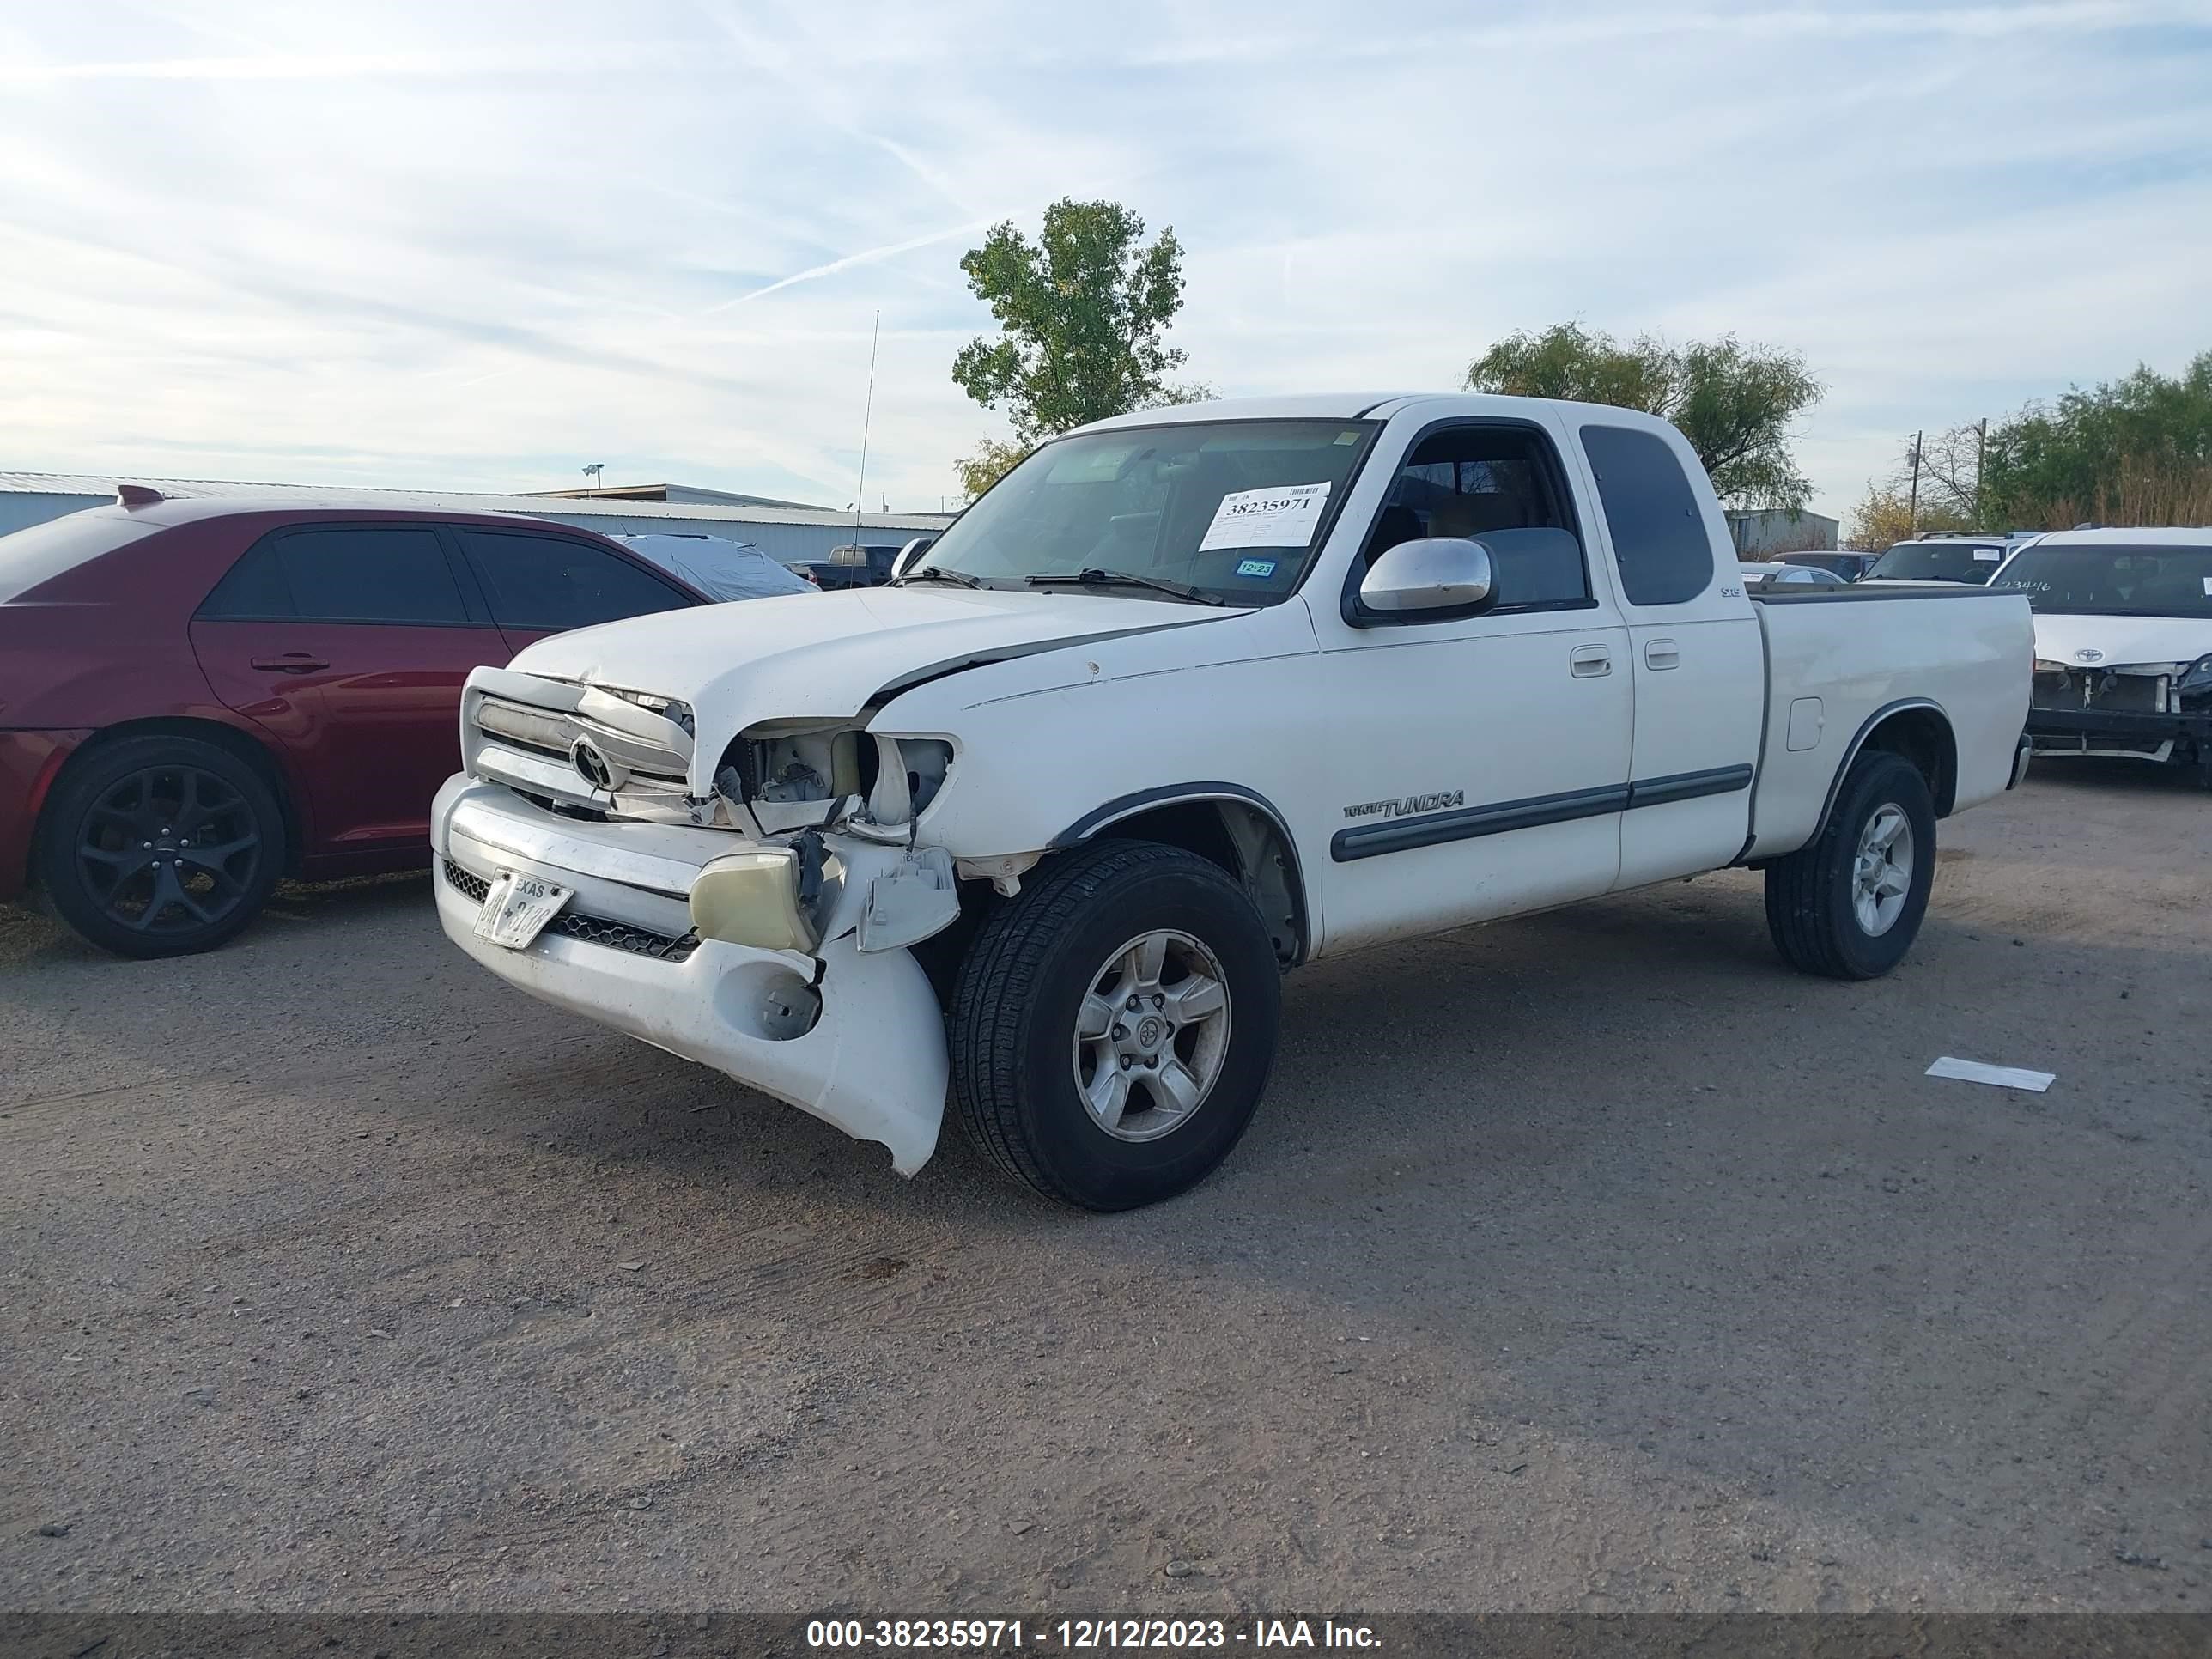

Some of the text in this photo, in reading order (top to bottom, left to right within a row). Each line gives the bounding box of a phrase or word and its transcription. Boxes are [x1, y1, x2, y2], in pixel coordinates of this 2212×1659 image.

[1225, 497, 1310, 516] 38235971
[1343, 789, 1465, 817] TOYOTA TUNDRA
[514, 878, 545, 898] EXAS
